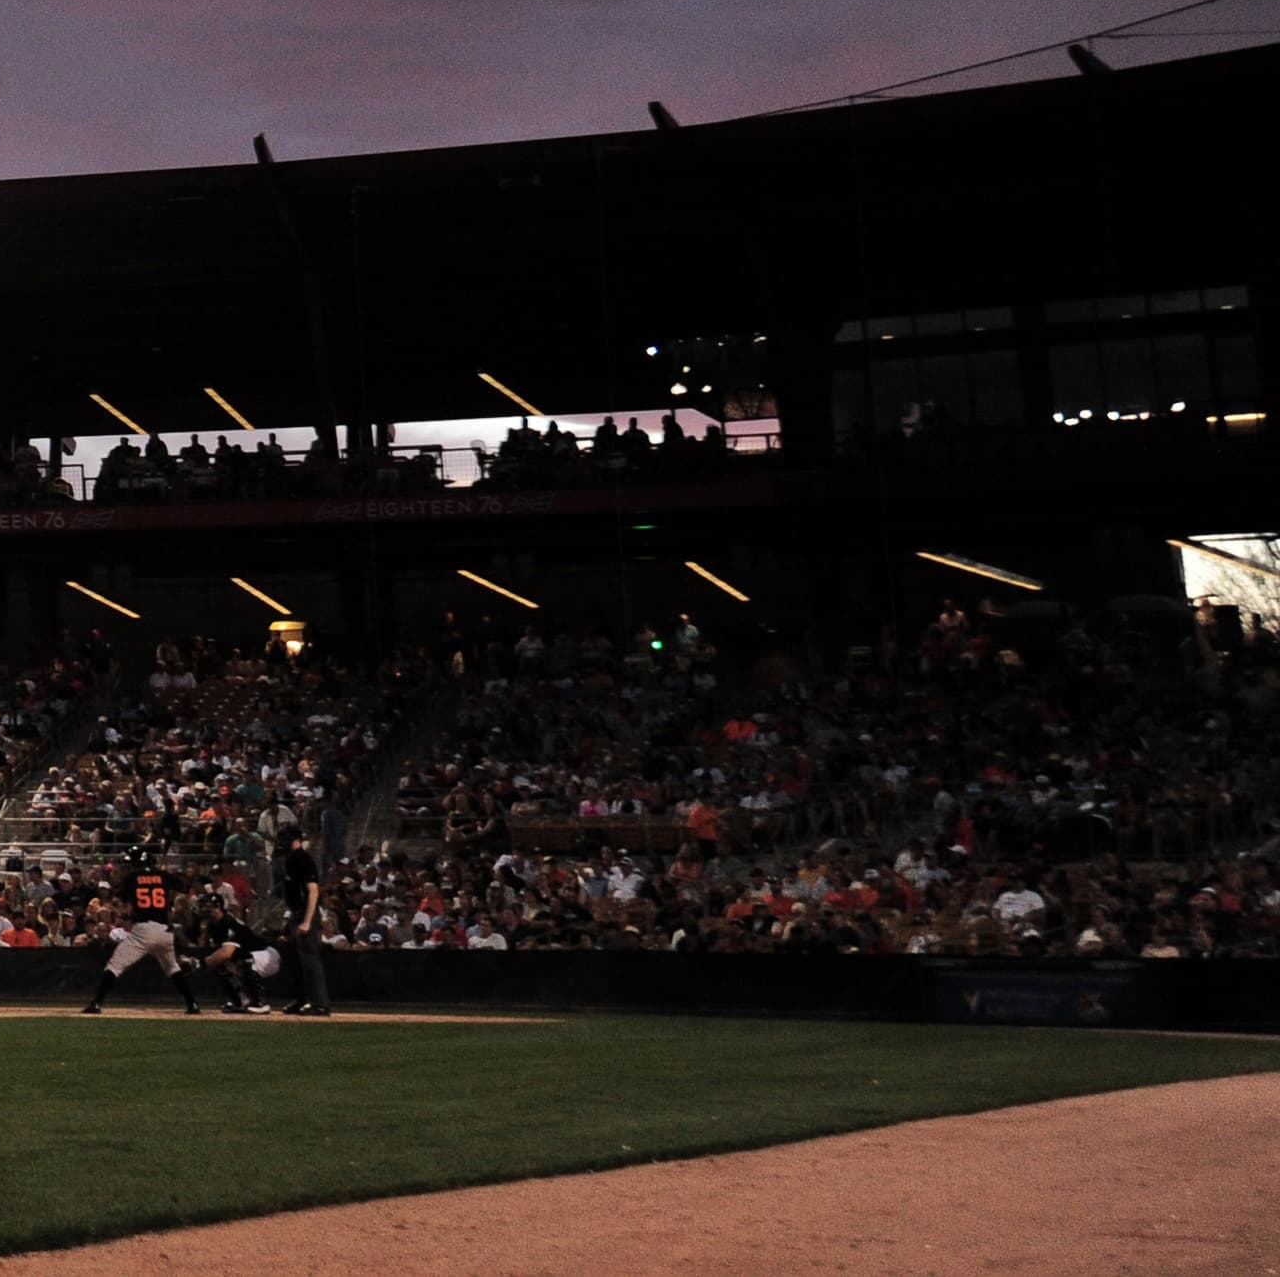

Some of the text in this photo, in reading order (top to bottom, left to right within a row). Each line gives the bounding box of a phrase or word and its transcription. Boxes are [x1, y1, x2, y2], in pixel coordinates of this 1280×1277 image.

[366, 498, 471, 517] EIGHTEEN
[478, 495, 501, 514] 76
[43, 510, 65, 529] 76
[135, 887, 167, 909] 56
